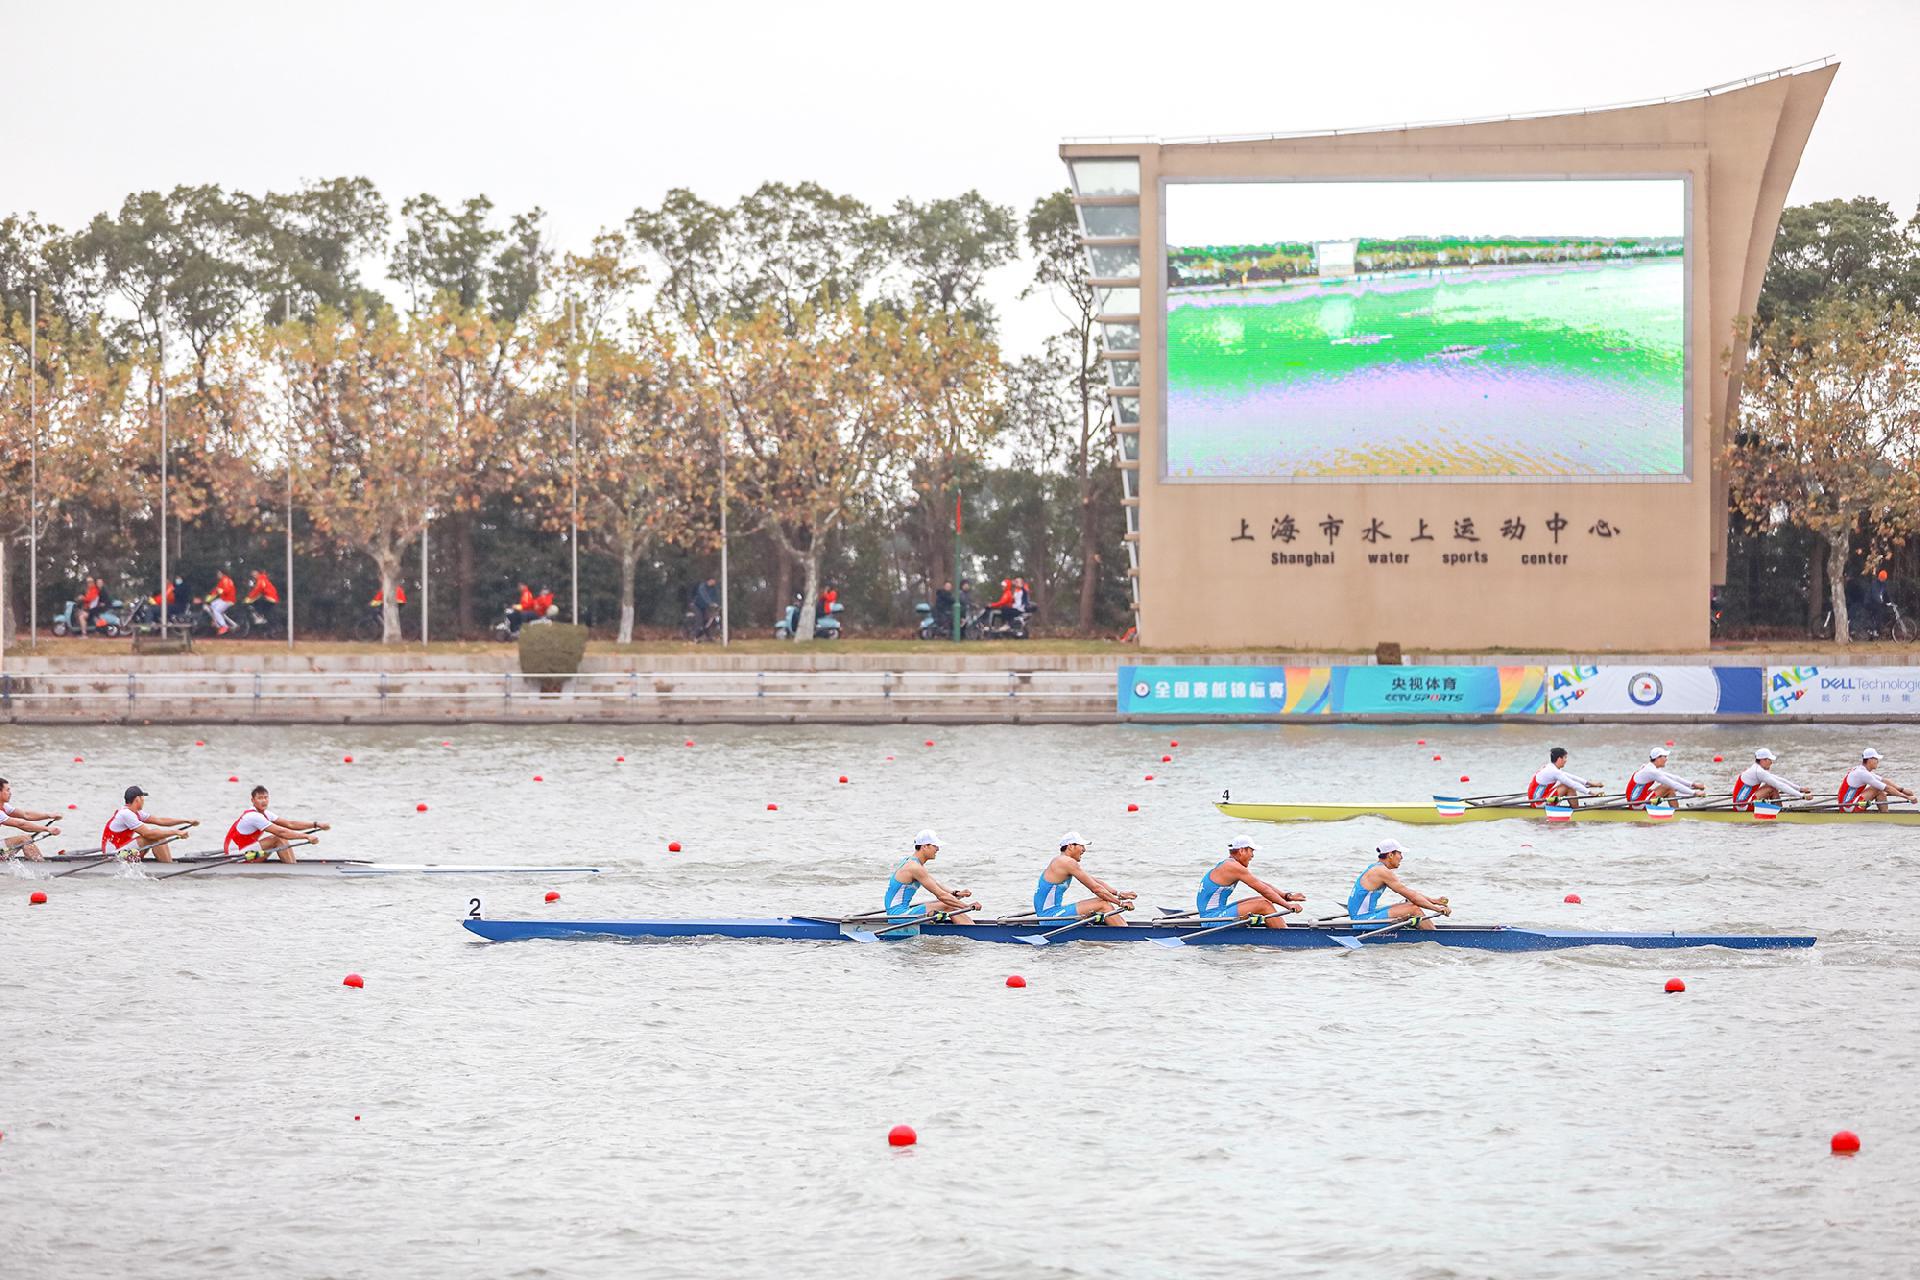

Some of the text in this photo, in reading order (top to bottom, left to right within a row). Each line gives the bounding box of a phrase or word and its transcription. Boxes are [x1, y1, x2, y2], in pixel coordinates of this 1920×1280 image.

[1230, 512, 1621, 546] 上海市水上运动中心
[1271, 551, 1569, 567] Shanghai water sports center
[1155, 681, 1284, 699] 全国赛艇锦标赛
[1391, 676, 1457, 691] 央视体育
[1821, 678, 1856, 690] DELL
[1412, 693, 1464, 702] SPORTS
[1222, 789, 1230, 801] 4
[469, 897, 481, 917] 2
